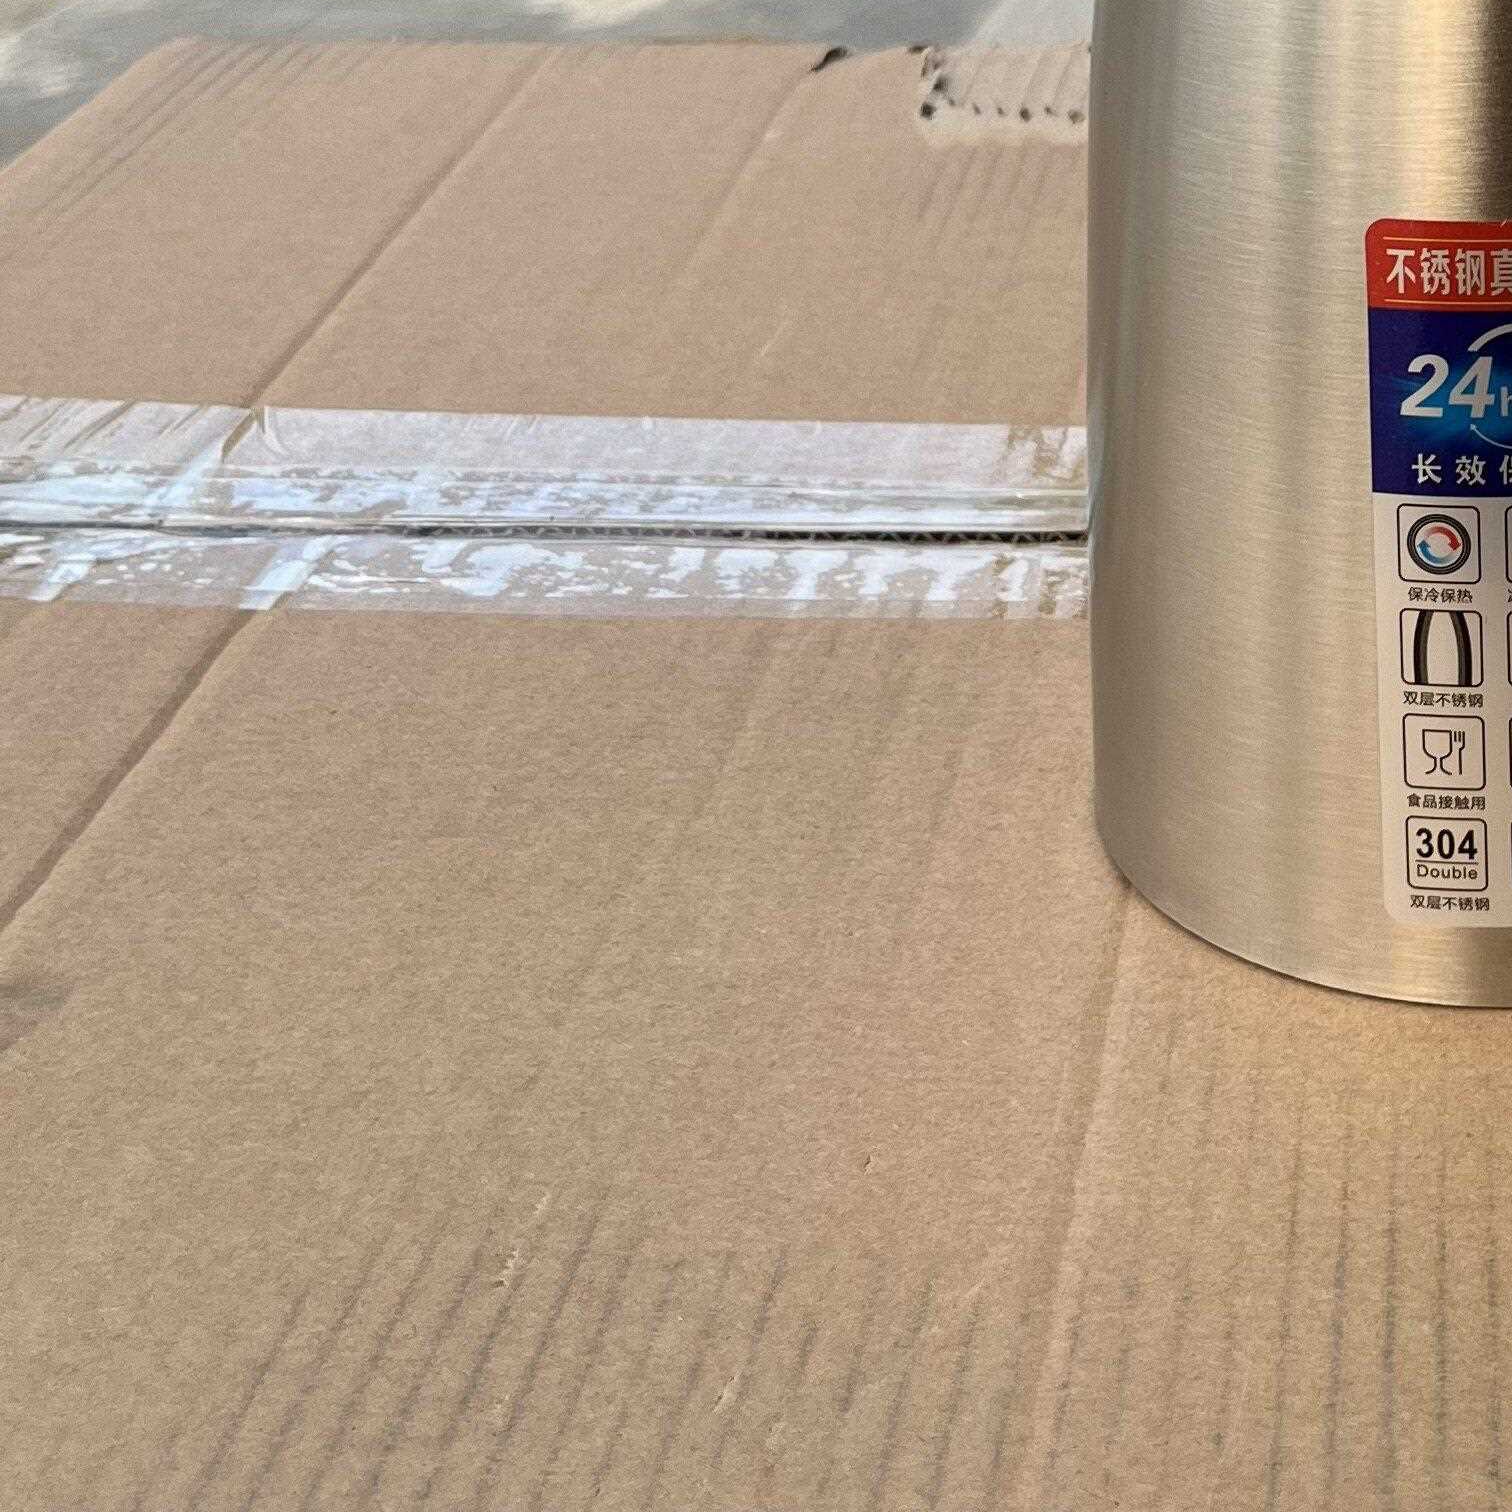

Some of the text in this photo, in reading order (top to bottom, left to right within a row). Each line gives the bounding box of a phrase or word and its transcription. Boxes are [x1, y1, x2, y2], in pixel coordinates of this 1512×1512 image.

[1407, 586, 1473, 604] 保冷保热
[1403, 691, 1484, 708] 双层不锈钢
[1407, 793, 1486, 810] 食品接触用
[1415, 828, 1478, 860] 304
[1416, 863, 1478, 881] Double
[1410, 894, 1490, 911] 双层不锈钢
